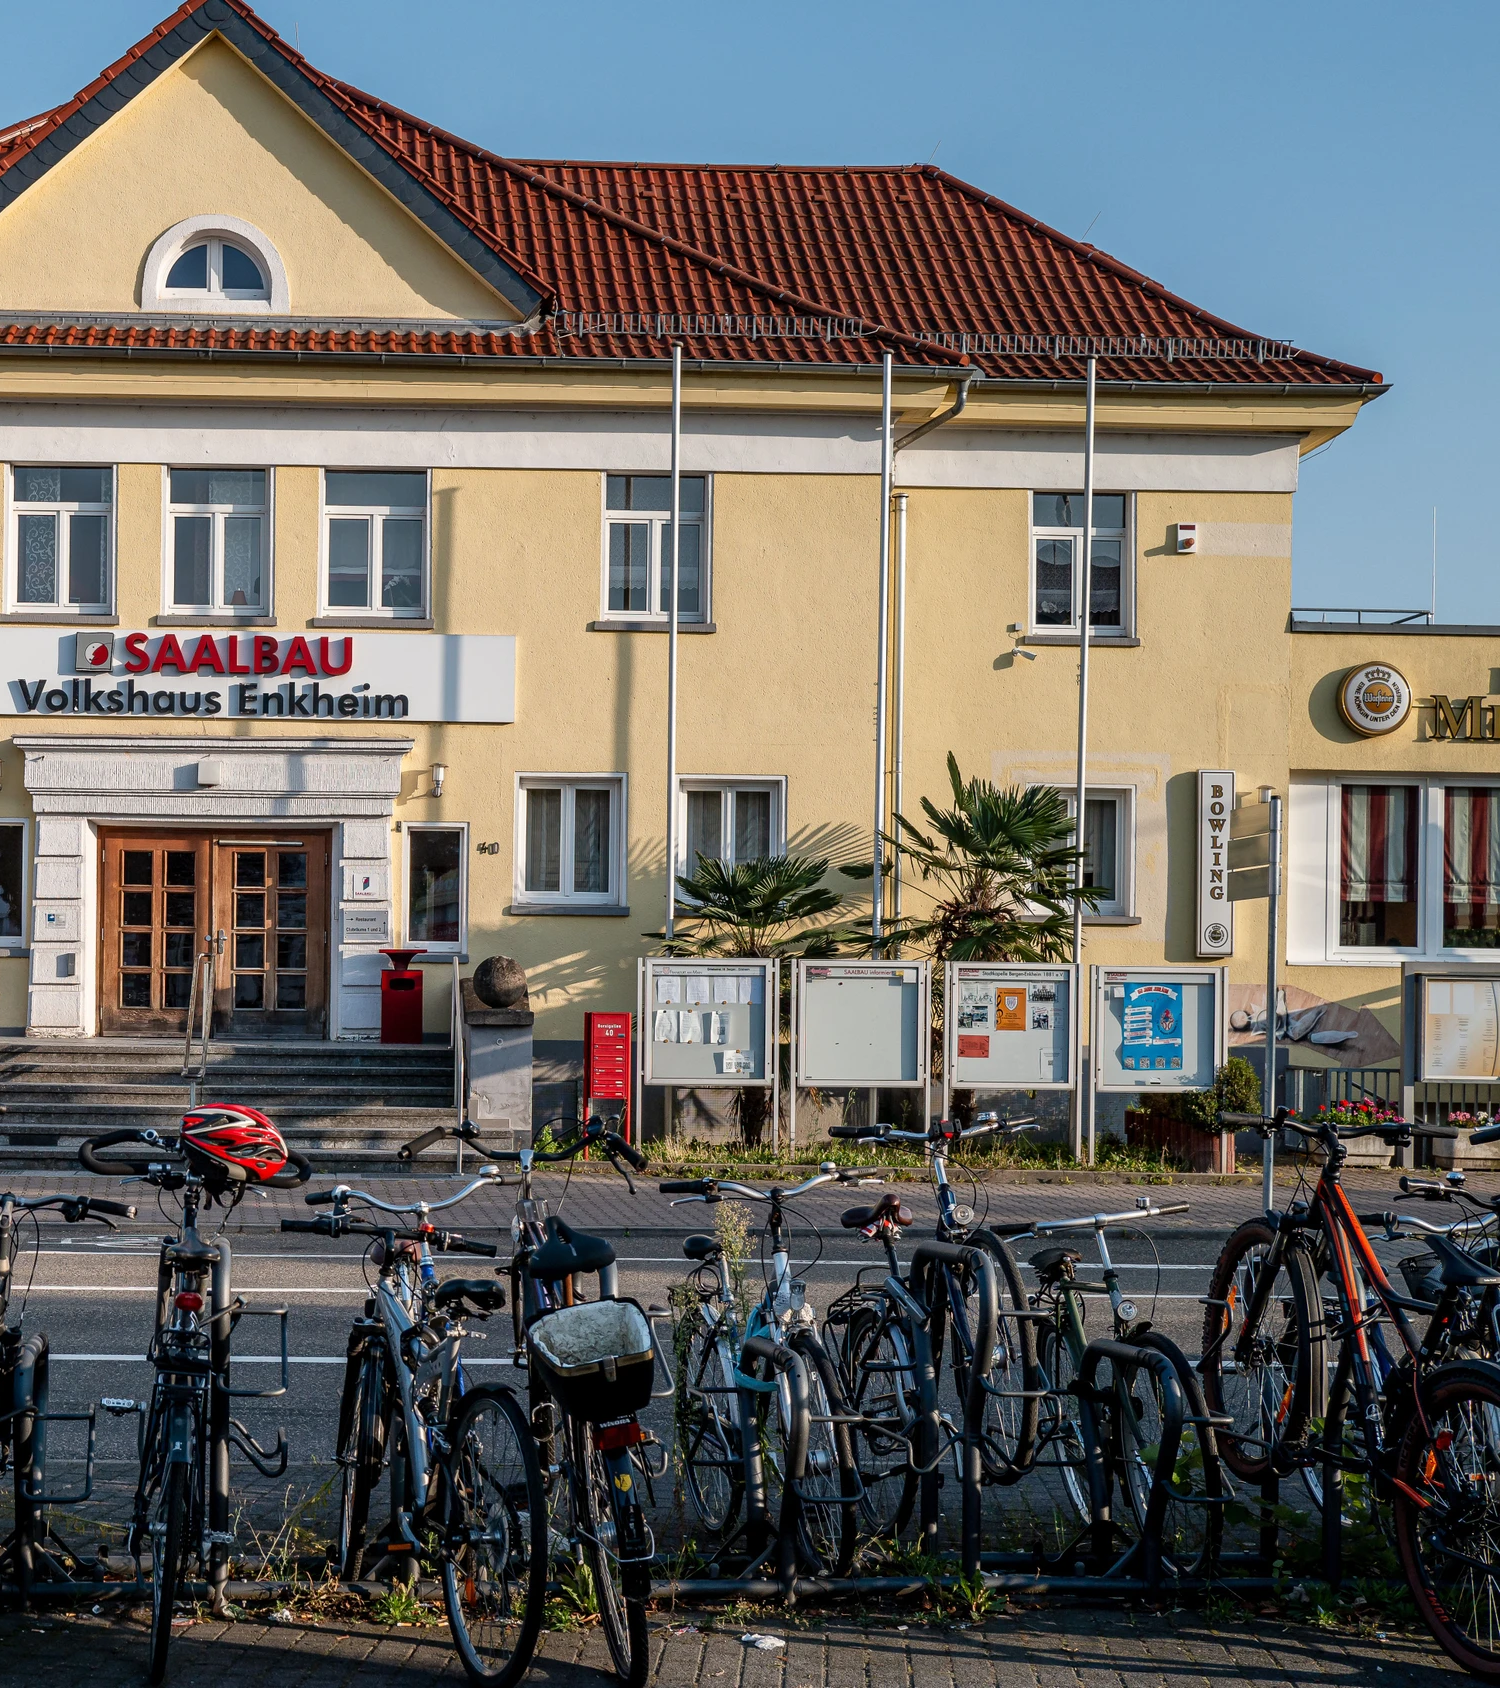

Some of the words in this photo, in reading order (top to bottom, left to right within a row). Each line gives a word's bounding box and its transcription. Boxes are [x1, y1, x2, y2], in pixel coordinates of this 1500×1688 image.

[124, 632, 353, 676] SAALBAU
[1354, 681, 1366, 696] EINE
[17, 678, 222, 715] Volkshaus
[238, 682, 409, 717] Enkheim
[1353, 695, 1370, 720] KÖNIGIN
[1389, 704, 1400, 718] DEN
[1369, 714, 1391, 723] UNTER
[476, 841, 499, 855] 40
[1208, 784, 1226, 900] BOWLING
[605, 1029, 614, 1037] 40
